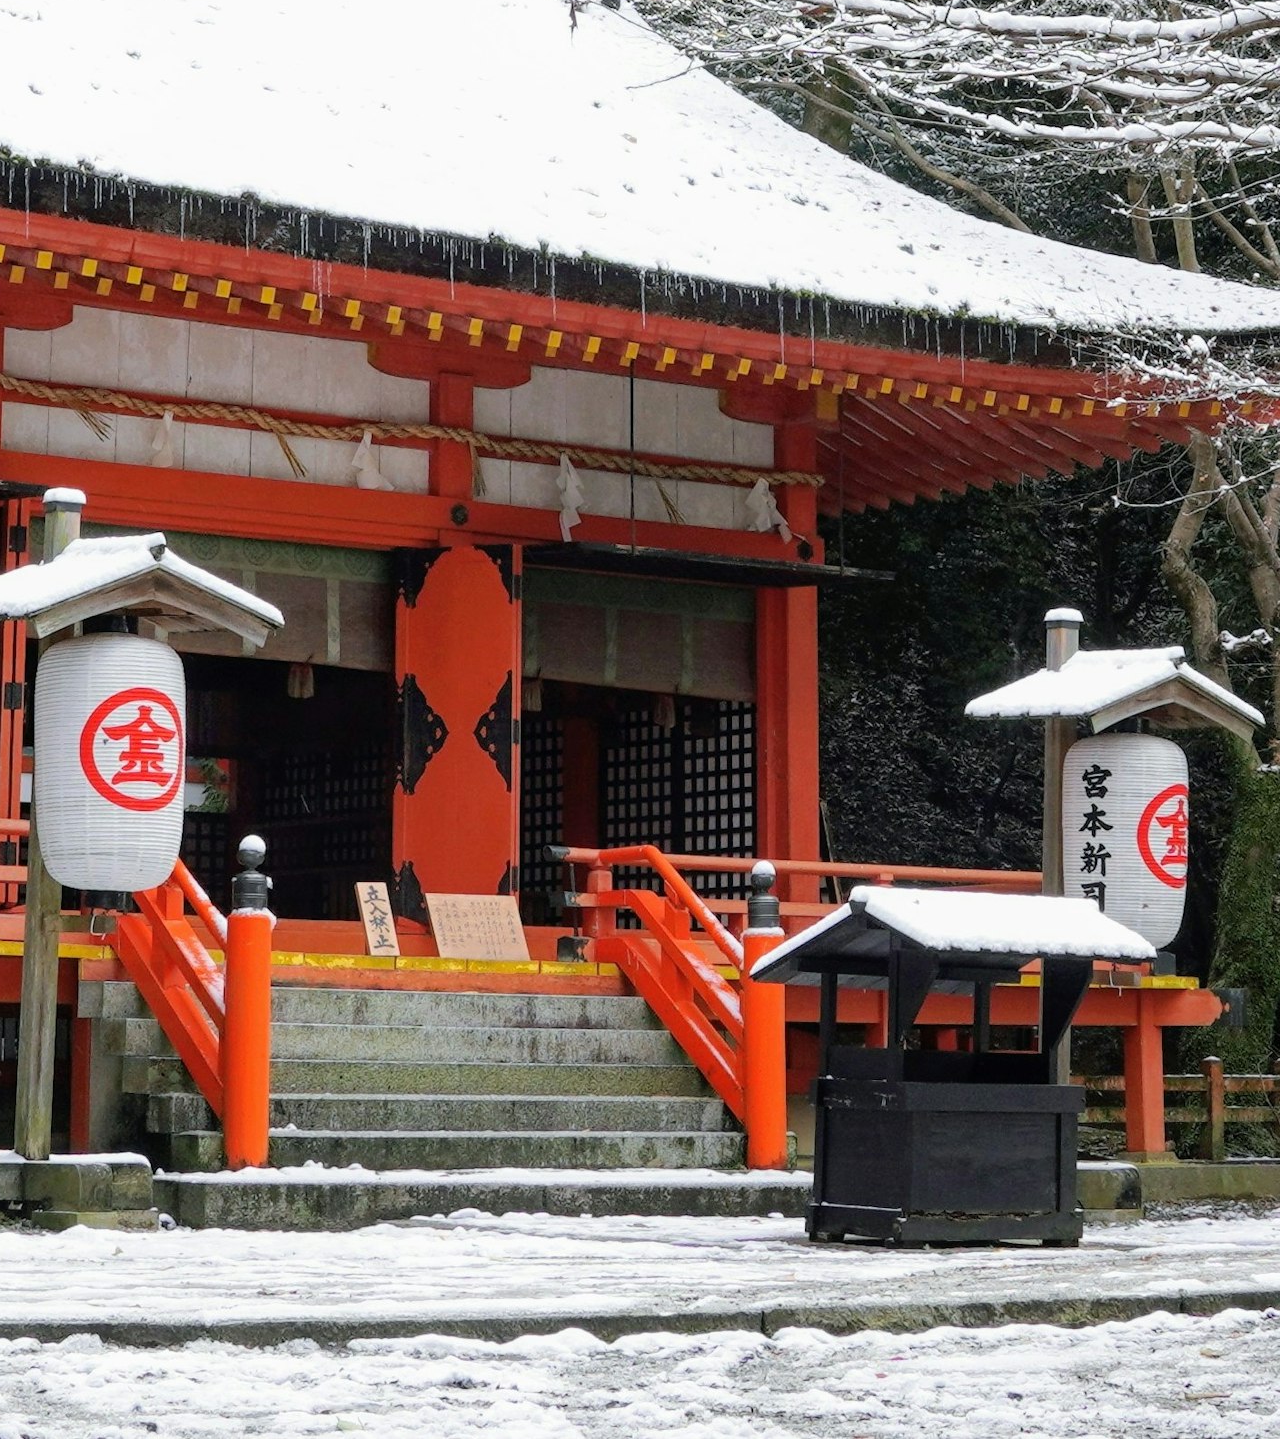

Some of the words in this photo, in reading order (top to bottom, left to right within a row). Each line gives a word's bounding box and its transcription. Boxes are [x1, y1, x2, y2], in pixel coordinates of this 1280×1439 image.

[103, 705, 176, 787] 金
[364, 885, 395, 950] 立入禁止
